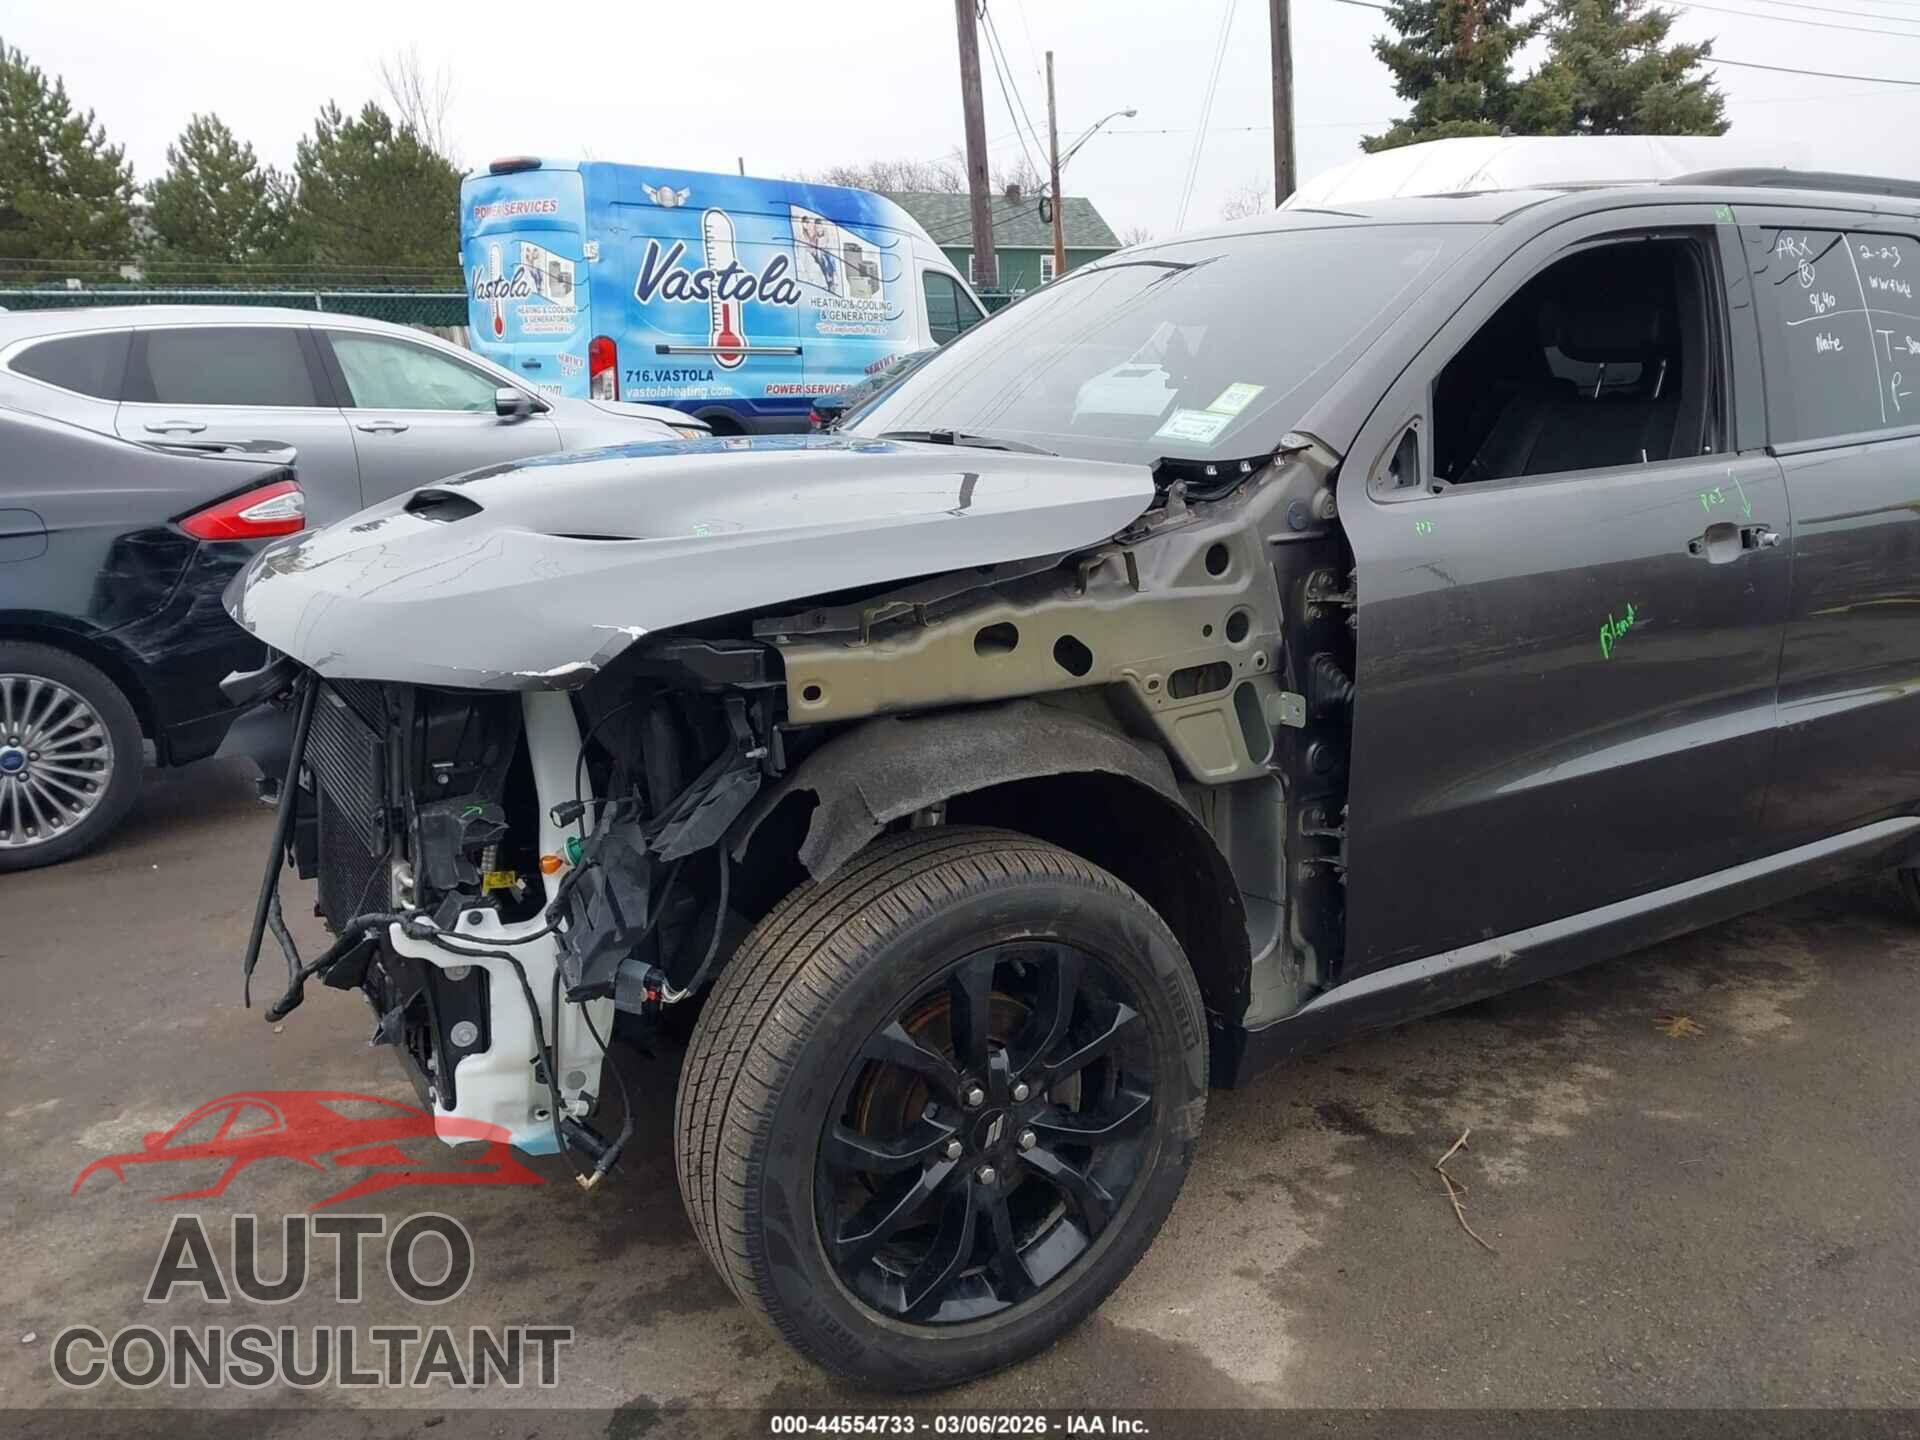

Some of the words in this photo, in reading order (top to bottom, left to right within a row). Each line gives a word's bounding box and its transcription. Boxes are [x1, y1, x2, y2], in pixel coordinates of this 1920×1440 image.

[503, 200, 557, 216] SERVICES
[636, 241, 802, 305] Vastola
[472, 264, 531, 300] Vastola
[811, 296, 847, 309] HEATING
[855, 299, 893, 312] COOLING
[829, 310, 884, 322] GENERATORS
[626, 369, 714, 382] 716.VASTOLA
[625, 384, 733, 399] vastolaheating.com
[766, 384, 802, 394] POWER
